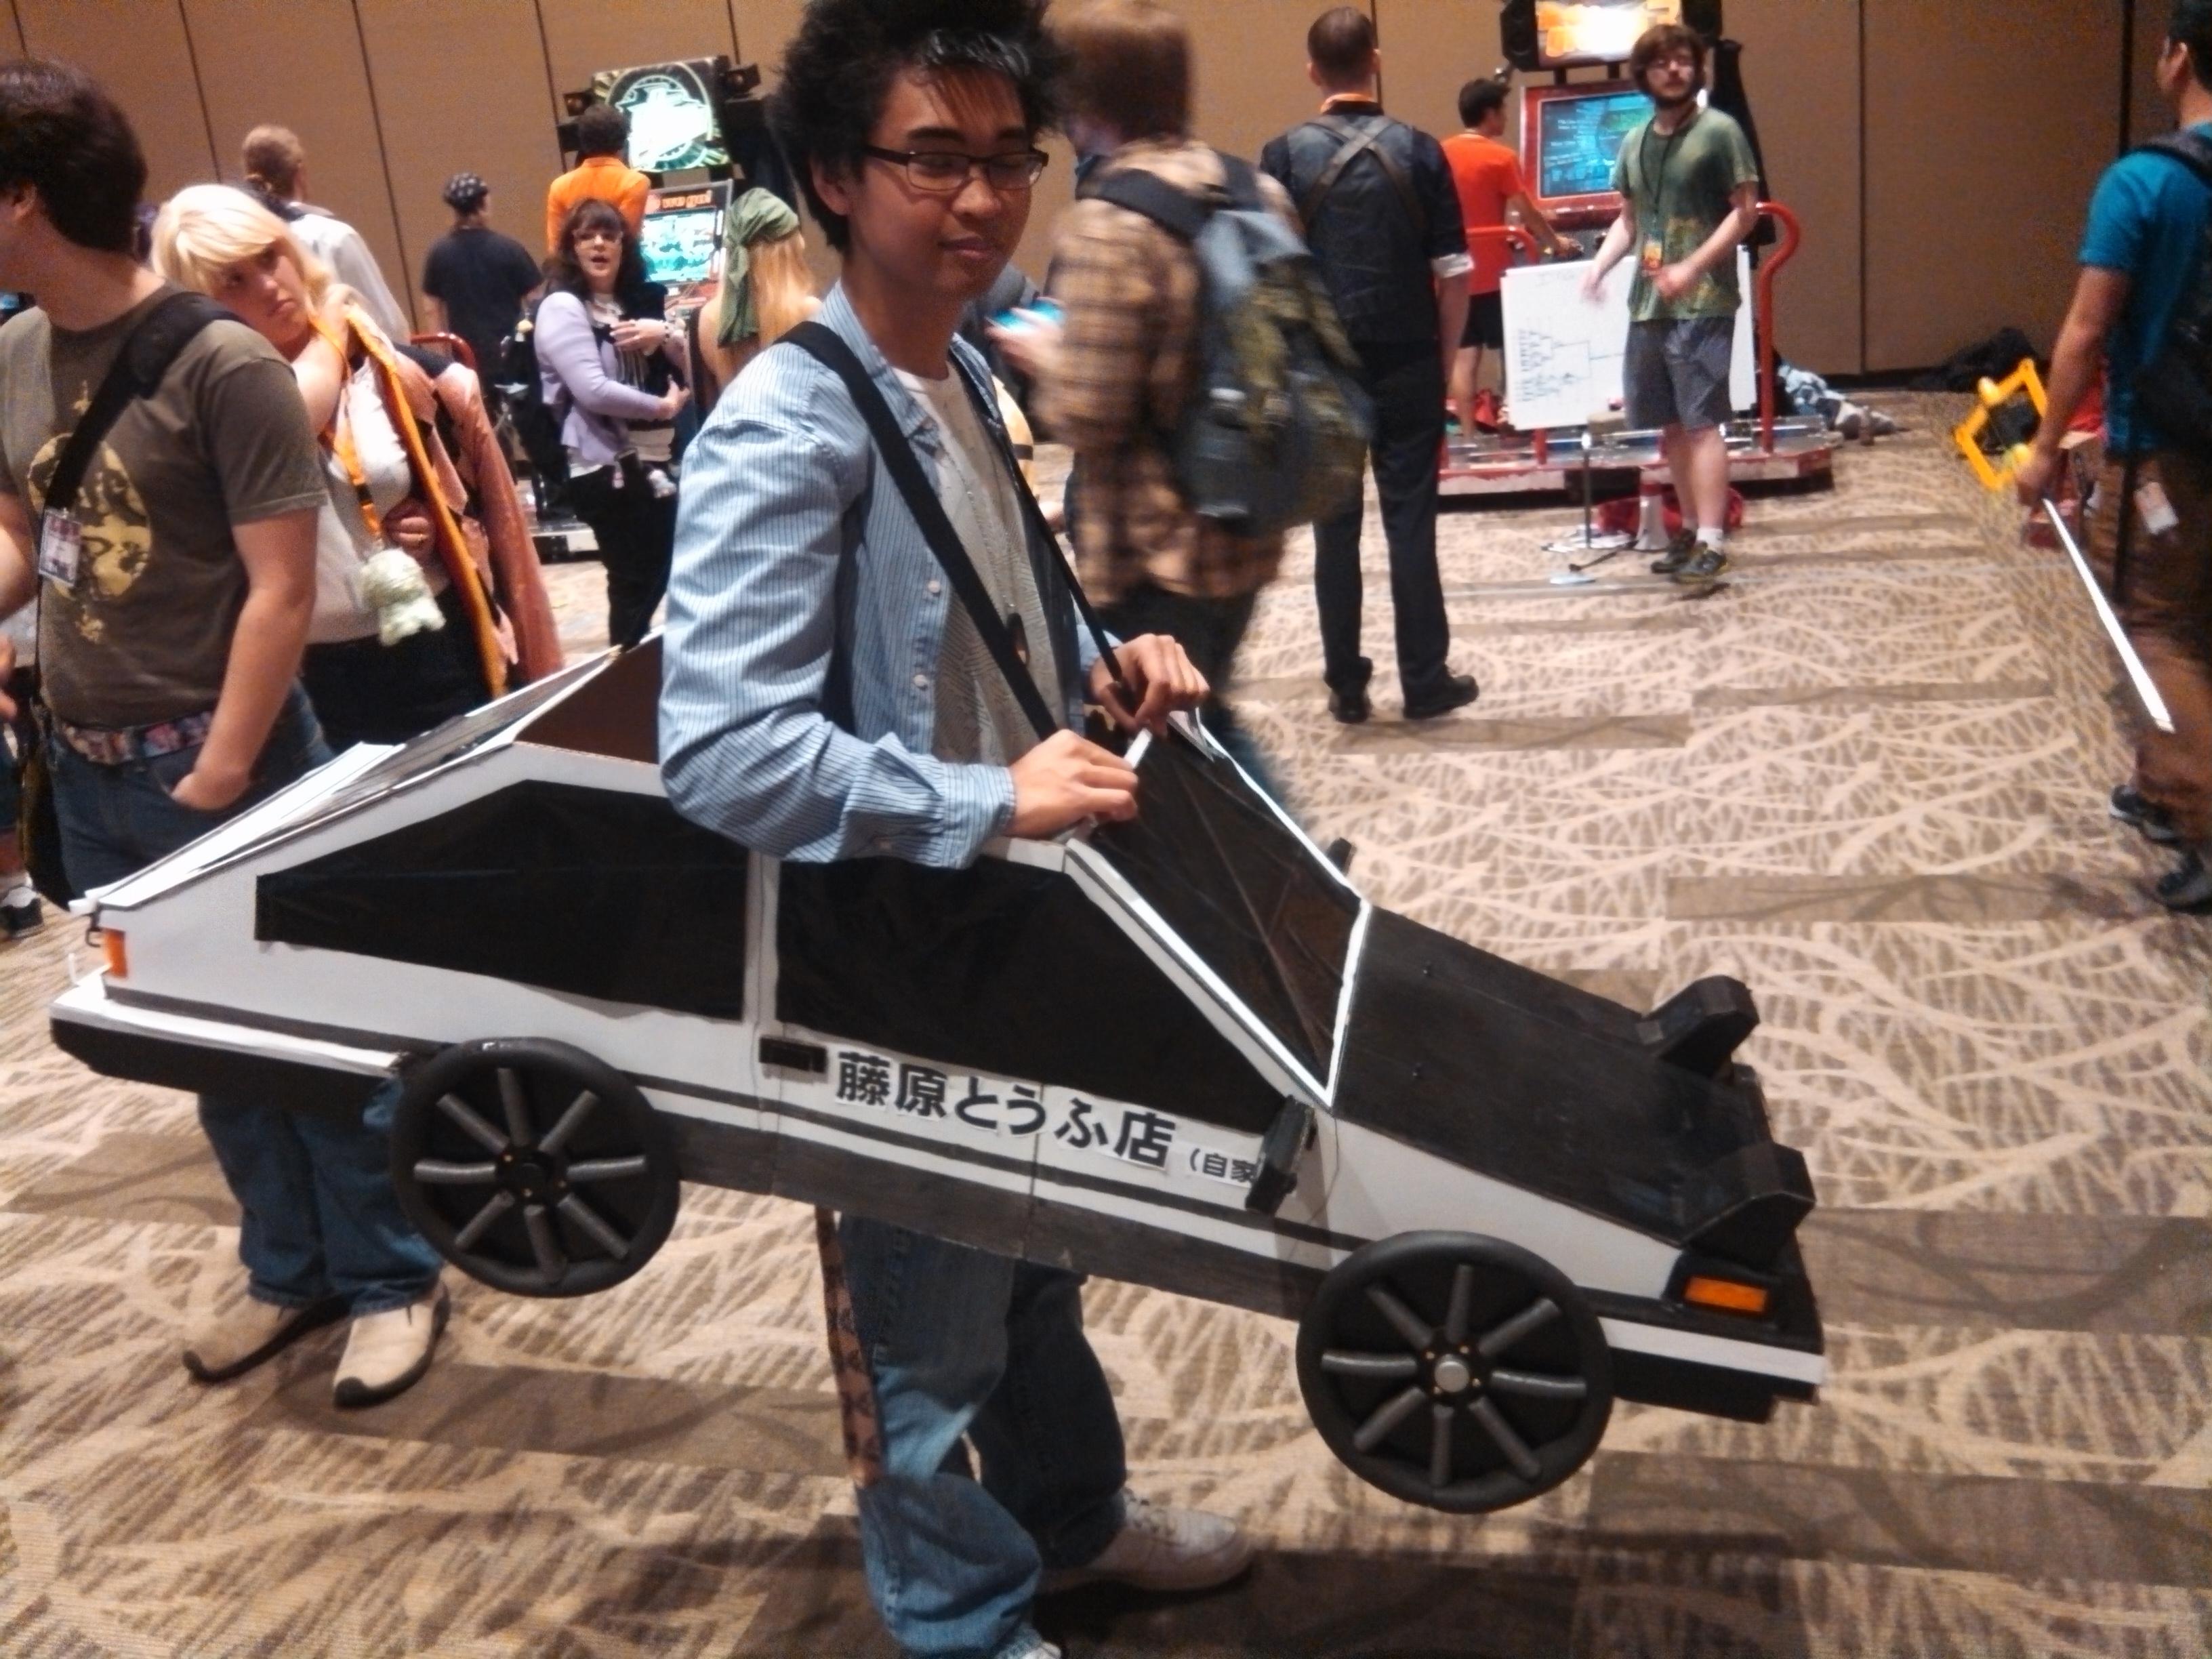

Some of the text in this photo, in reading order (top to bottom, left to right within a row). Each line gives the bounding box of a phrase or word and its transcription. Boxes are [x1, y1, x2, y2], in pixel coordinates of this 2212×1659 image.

[836, 1050, 1176, 1168] 藤原とうふ店
